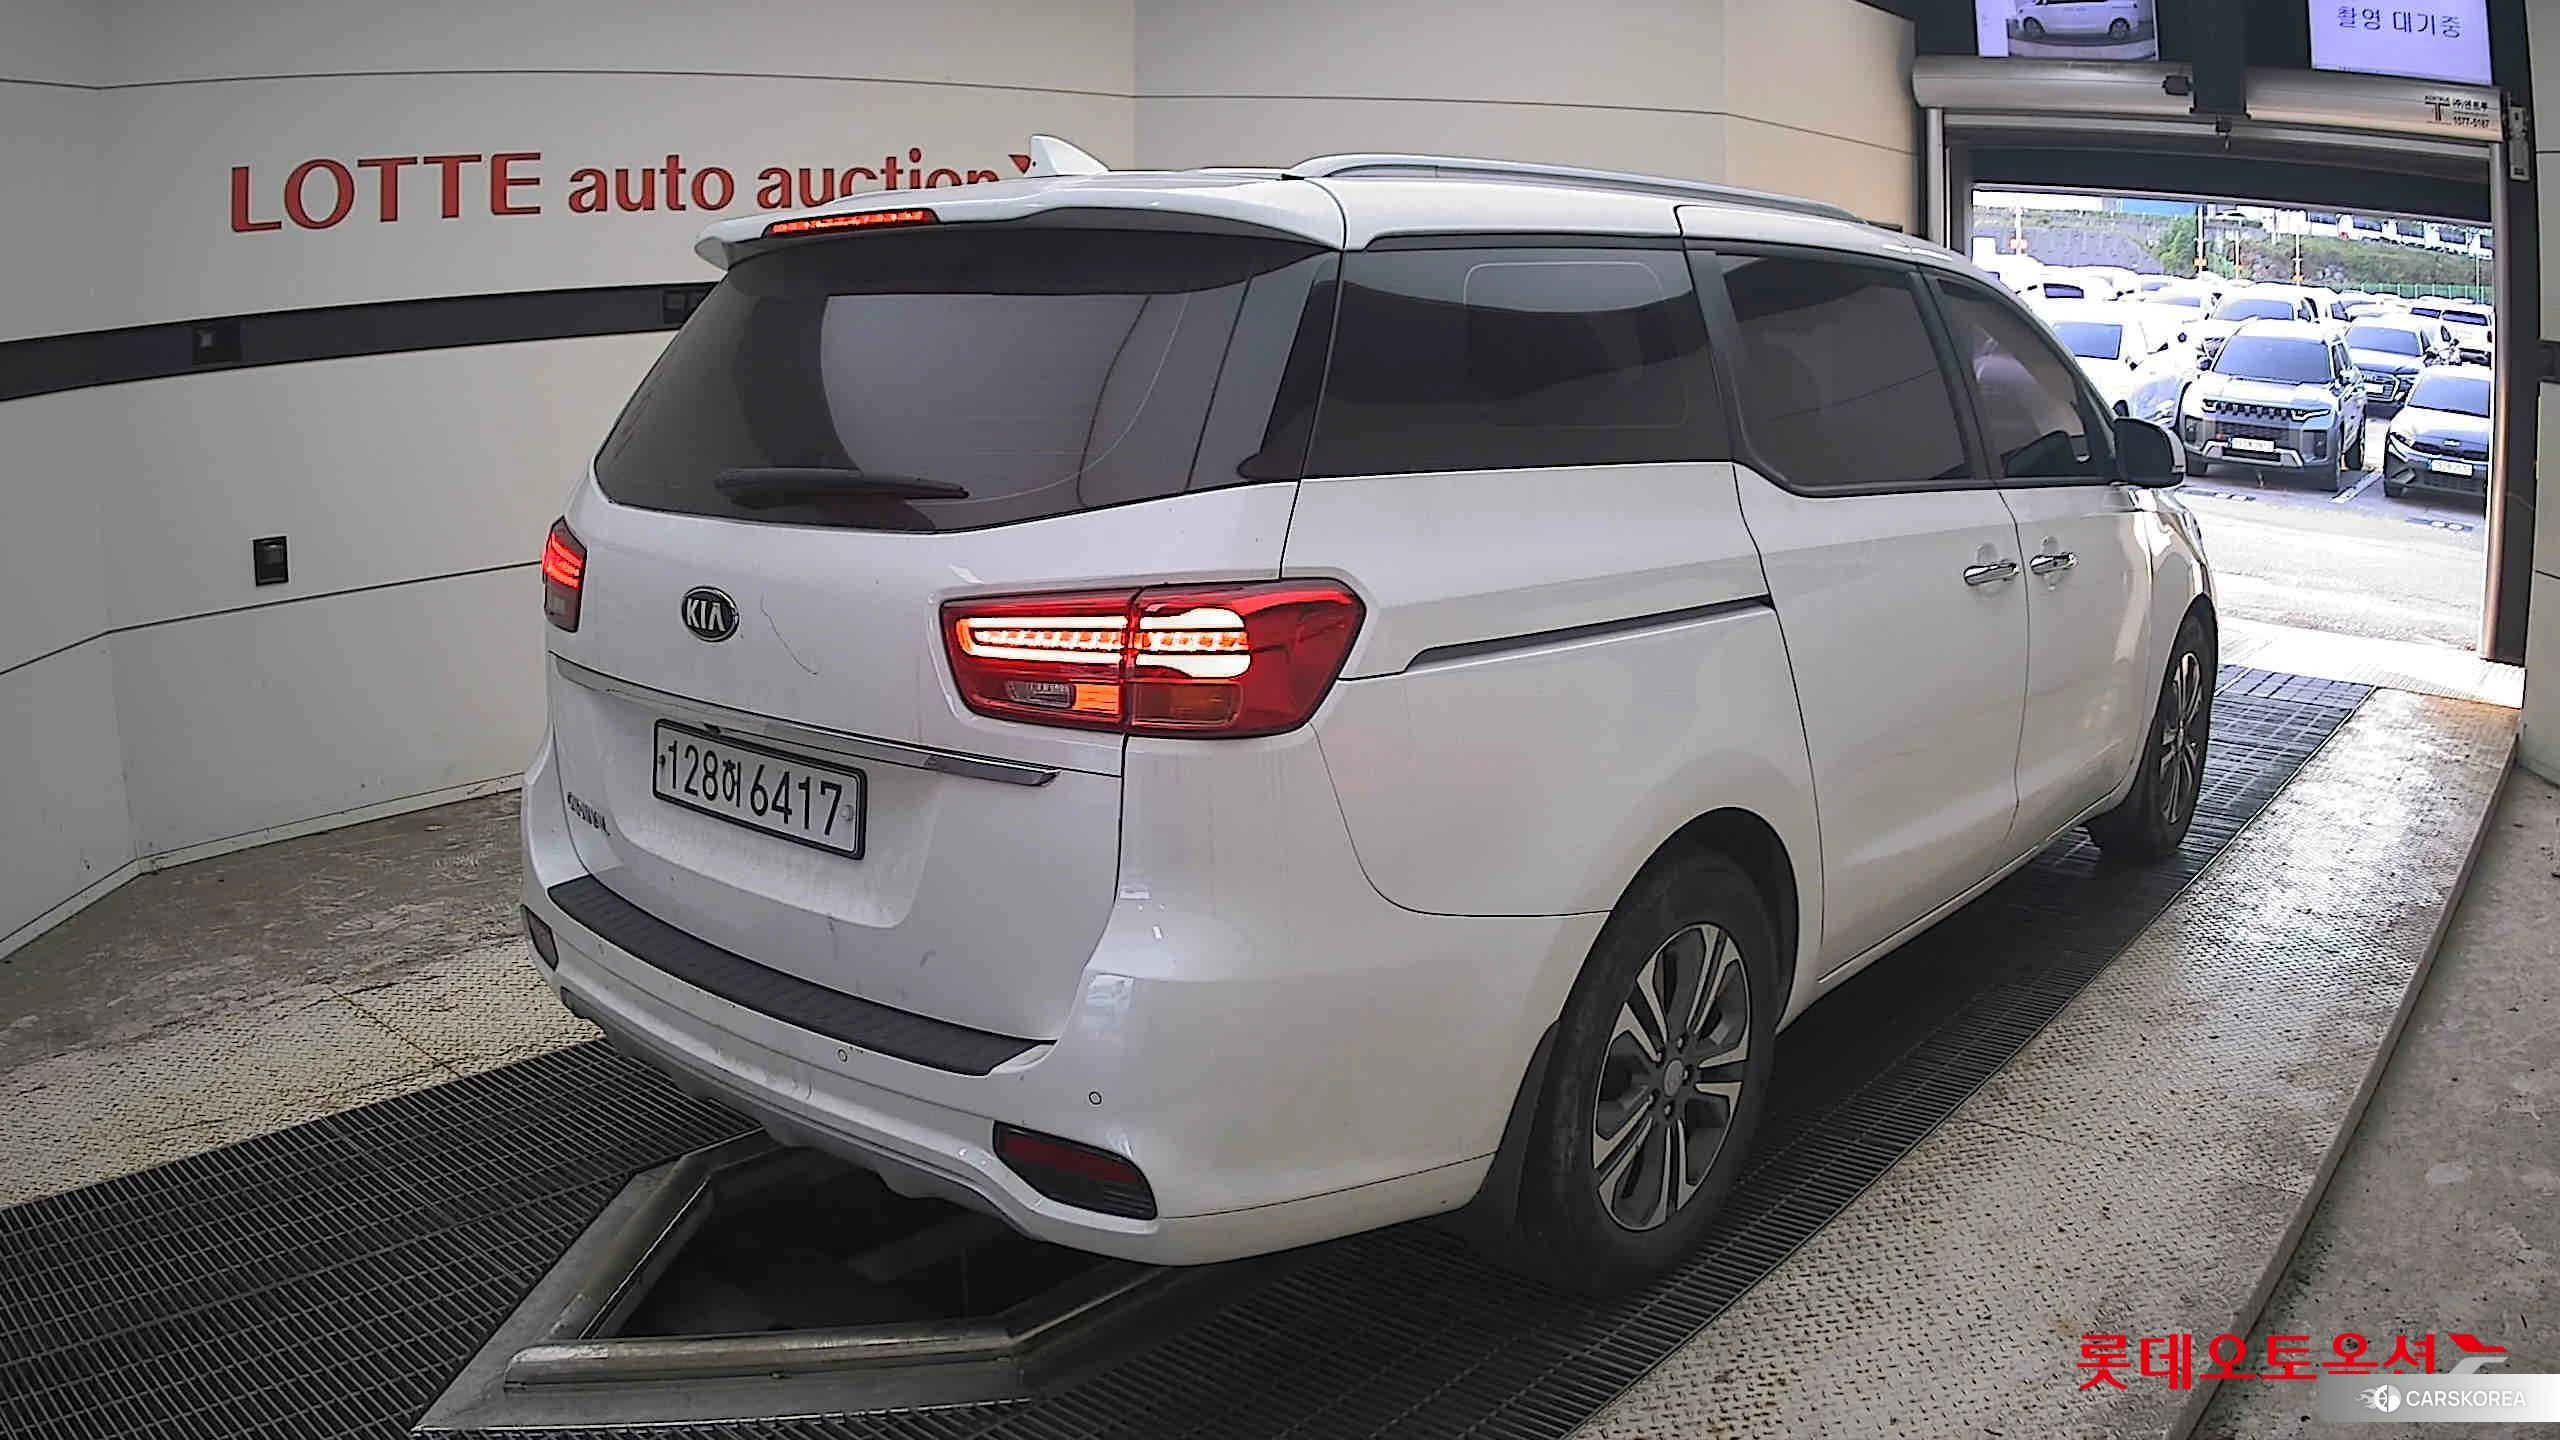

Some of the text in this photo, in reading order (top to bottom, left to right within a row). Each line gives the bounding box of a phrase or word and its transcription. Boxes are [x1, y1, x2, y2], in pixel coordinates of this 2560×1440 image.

[2338, 6, 2461, 39] 촬영 대기중
[231, 152, 541, 232] LOTTE
[568, 154, 735, 213] auto
[686, 597, 726, 632] KIA
[668, 740, 842, 836] 128허6417
